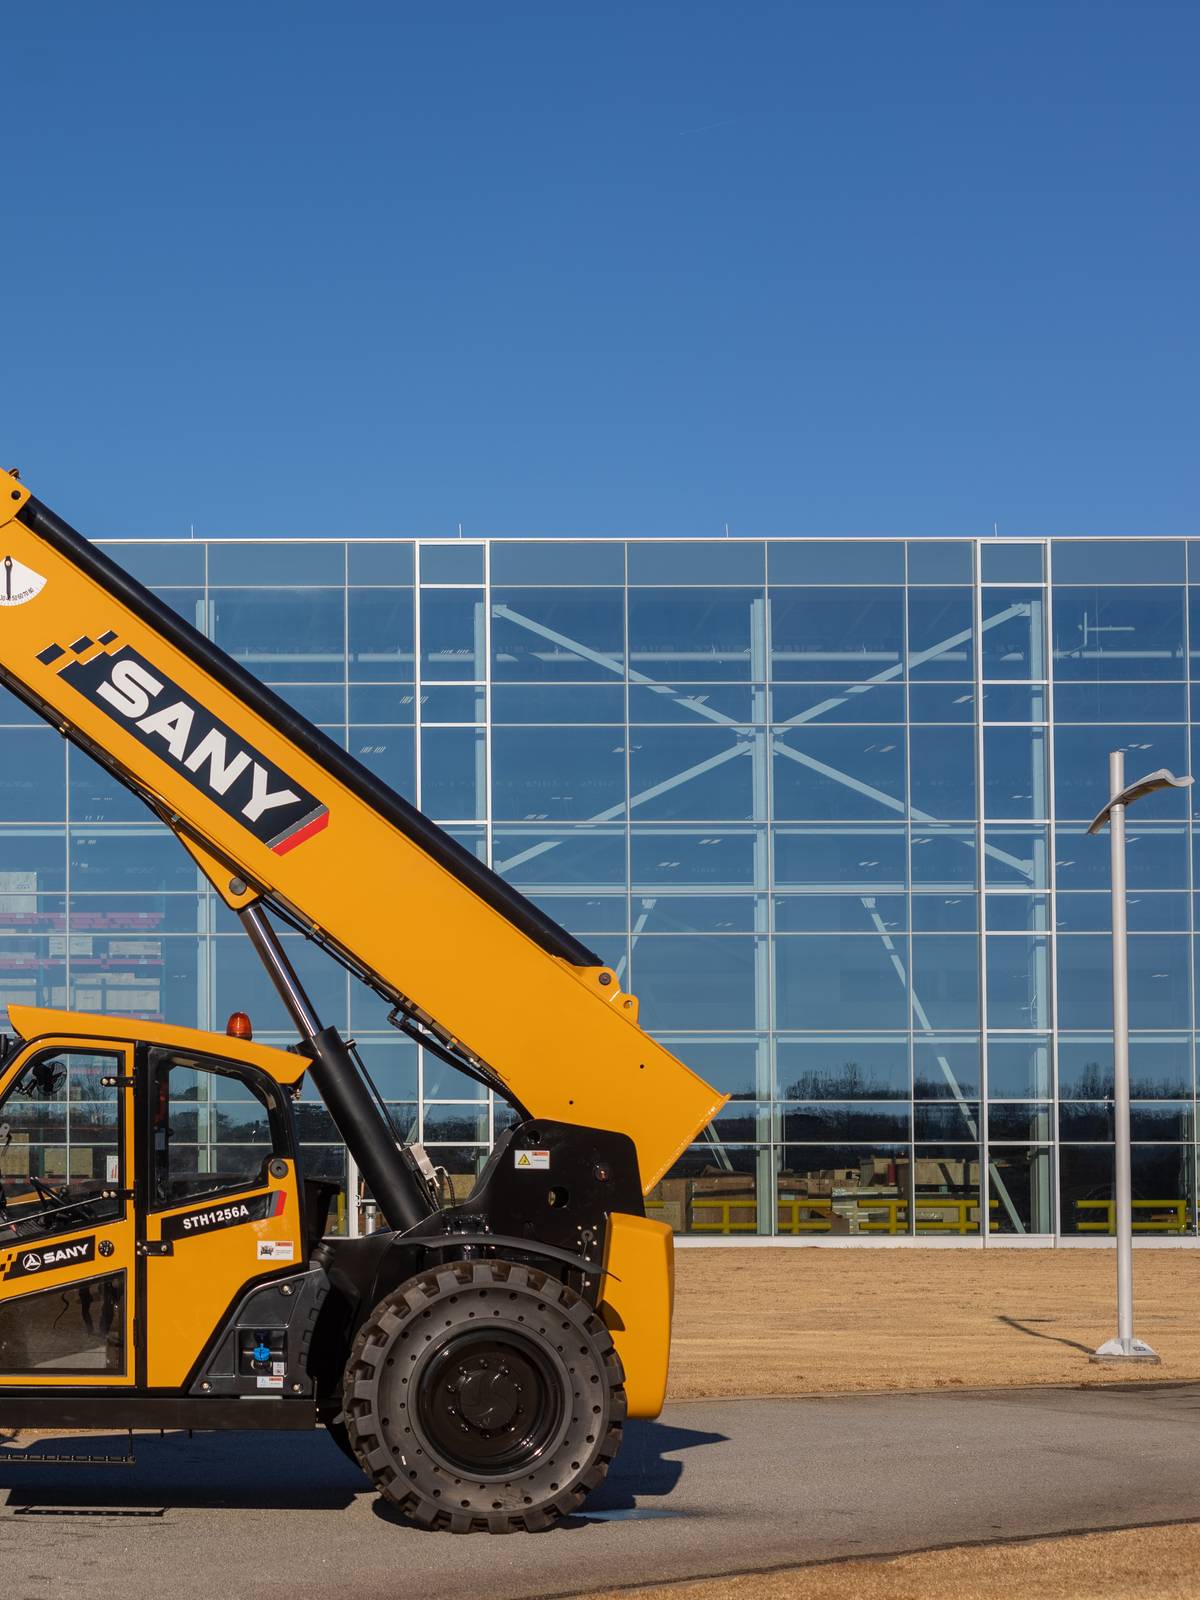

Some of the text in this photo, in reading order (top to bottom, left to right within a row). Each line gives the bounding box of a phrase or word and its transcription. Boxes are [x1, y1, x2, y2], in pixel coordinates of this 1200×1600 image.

[96, 660, 301, 822] SANY
[183, 1204, 249, 1229] STH1256A
[43, 1243, 88, 1264] SANY
